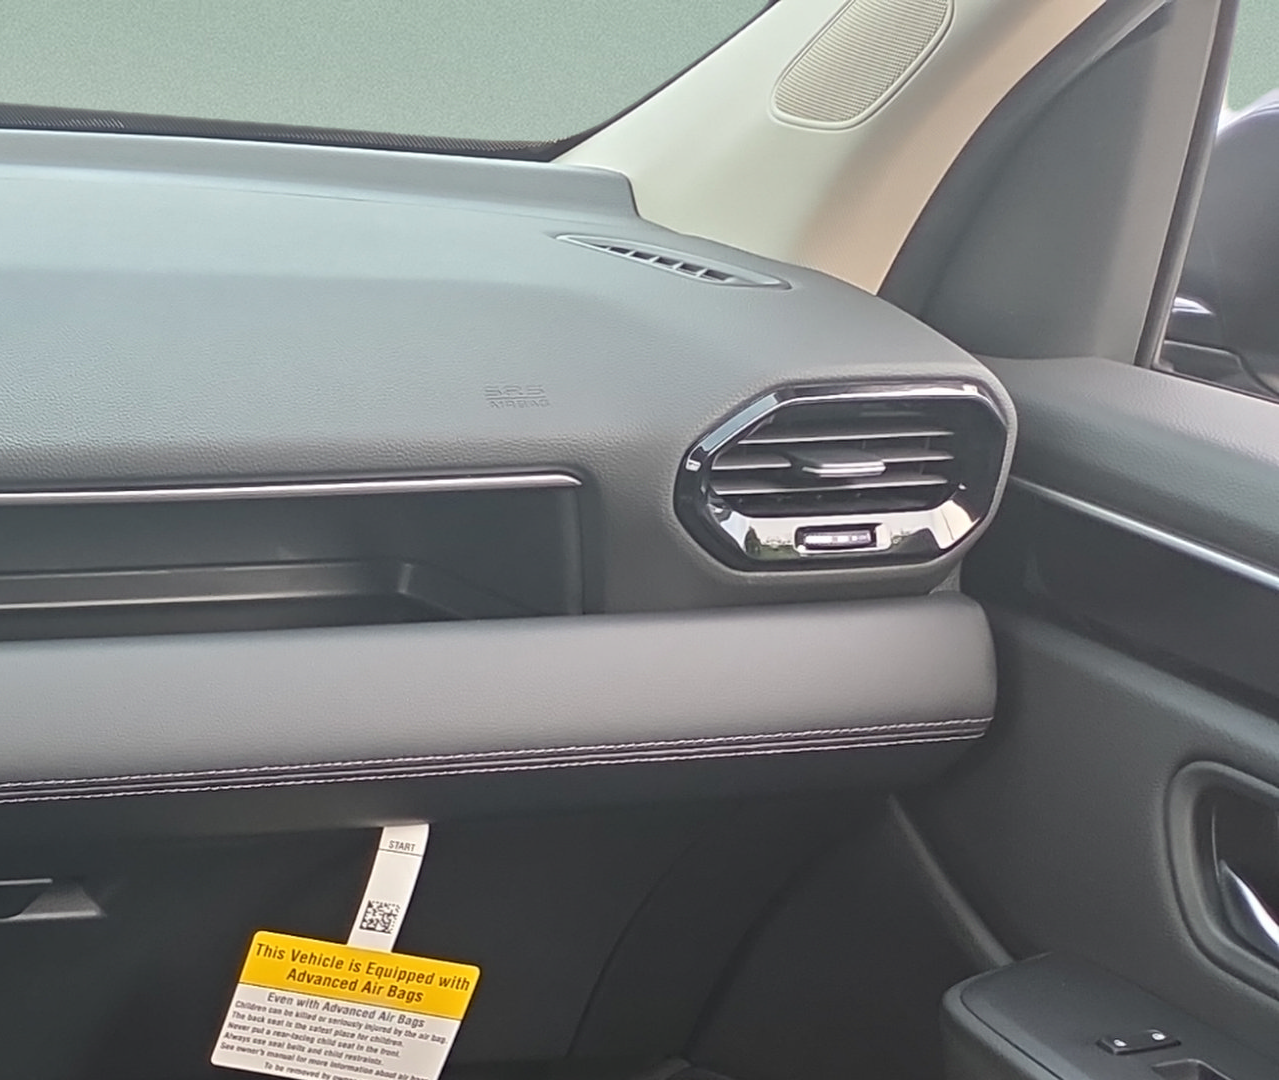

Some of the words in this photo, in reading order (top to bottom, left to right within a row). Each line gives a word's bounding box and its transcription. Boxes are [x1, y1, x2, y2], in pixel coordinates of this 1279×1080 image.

[388, 840, 416, 852] START
[255, 943, 285, 961] This
[290, 948, 345, 970] Vehicle
[348, 958, 362, 973] is
[365, 964, 435, 988] Equipped
[437, 974, 471, 992] with
[285, 967, 359, 992] Advanced
[361, 981, 384, 997] Air
[386, 985, 425, 1004] Bags
[235, 1000, 267, 1012] Children
[284, 1008, 294, 1017] be
[295, 1010, 317, 1021] killed
[328, 1016, 364, 1031] seriously
[364, 1021, 392, 1034] injured
[393, 1027, 403, 1037] by
[404, 1030, 417, 1039] the
[418, 1032, 430, 1041] air
[267, 992, 294, 1005] Even
[296, 998, 320, 1010] with
[322, 1001, 376, 1019] Advanced
[377, 1011, 396, 1023] Air
[397, 1014, 426, 1029] Bags
[223, 1031, 251, 1044] Always
[252, 1037, 266, 1045] use
[268, 1039, 285, 1048] seat
[286, 1041, 306, 1052] belts
[307, 1045, 322, 1055] and
[323, 1049, 344, 1059] child
[227, 1021, 250, 1032] Never
[251, 1026, 264, 1035] put
[272, 1029, 316, 1044] rear-facing
[316, 1036, 337, 1047] child
[337, 1040, 355, 1049] seat
[365, 1044, 378, 1054] the
[231, 1011, 246, 1020] The
[247, 1013, 265, 1023] back
[267, 1017, 284, 1027] seat
[294, 1021, 307, 1030] the
[309, 1024, 333, 1035] safest
[334, 1027, 355, 1038] place
[357, 1032, 369, 1040] for
[369, 1034, 404, 1047] children.
[220, 1041, 234, 1051] See
[266, 1050, 295, 1061] manual
[296, 1053, 307, 1063] for
[308, 1057, 328, 1067] more
[329, 1061, 374, 1075] information
[374, 1068, 397, 1079] about
[397, 1072, 409, 1080] air
[264, 1061, 273, 1070] To
[274, 1064, 284, 1073] be
[286, 1066, 320, 1079] removed
[321, 1070, 332, 1080] by
